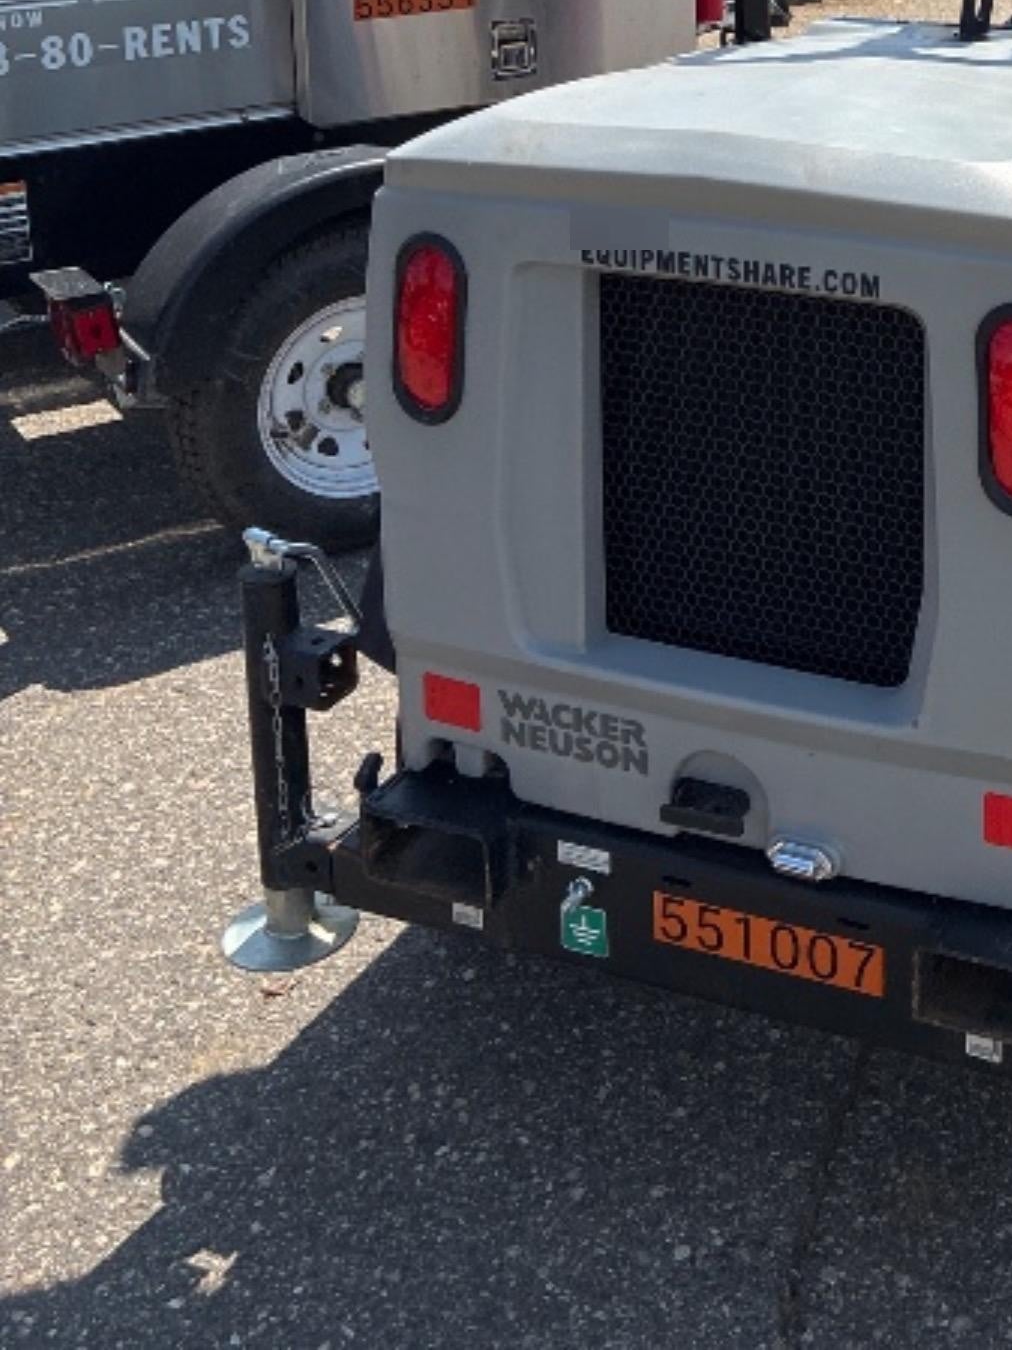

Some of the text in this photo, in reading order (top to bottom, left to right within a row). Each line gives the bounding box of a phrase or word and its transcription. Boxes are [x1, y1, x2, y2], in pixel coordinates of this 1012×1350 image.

[497, 689, 648, 748] WACKER
[500, 717, 649, 777] NEUSON
[660, 897, 877, 988] 551007
